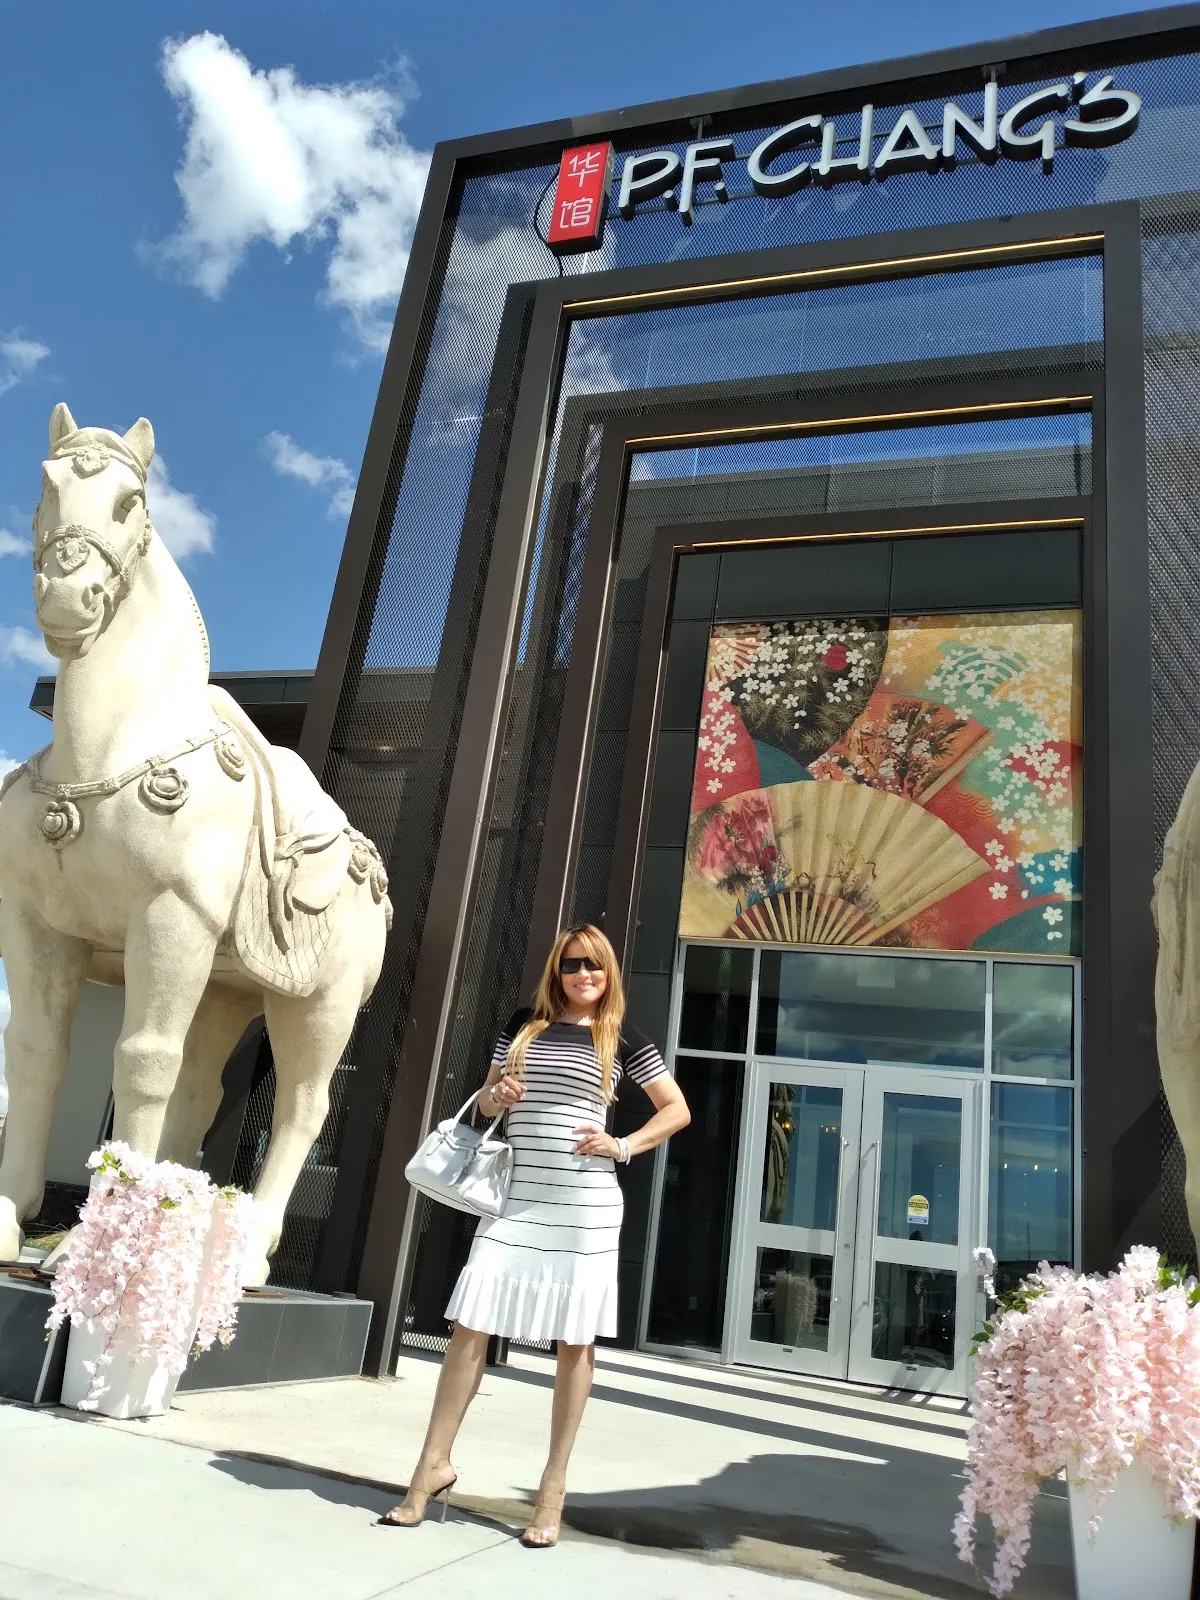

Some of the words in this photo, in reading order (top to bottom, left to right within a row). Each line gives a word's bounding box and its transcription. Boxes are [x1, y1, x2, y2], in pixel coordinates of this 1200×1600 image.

[559, 151, 601, 229] 华馆
[618, 138, 733, 213] P.F.
[747, 71, 1142, 185] CHANG'S
